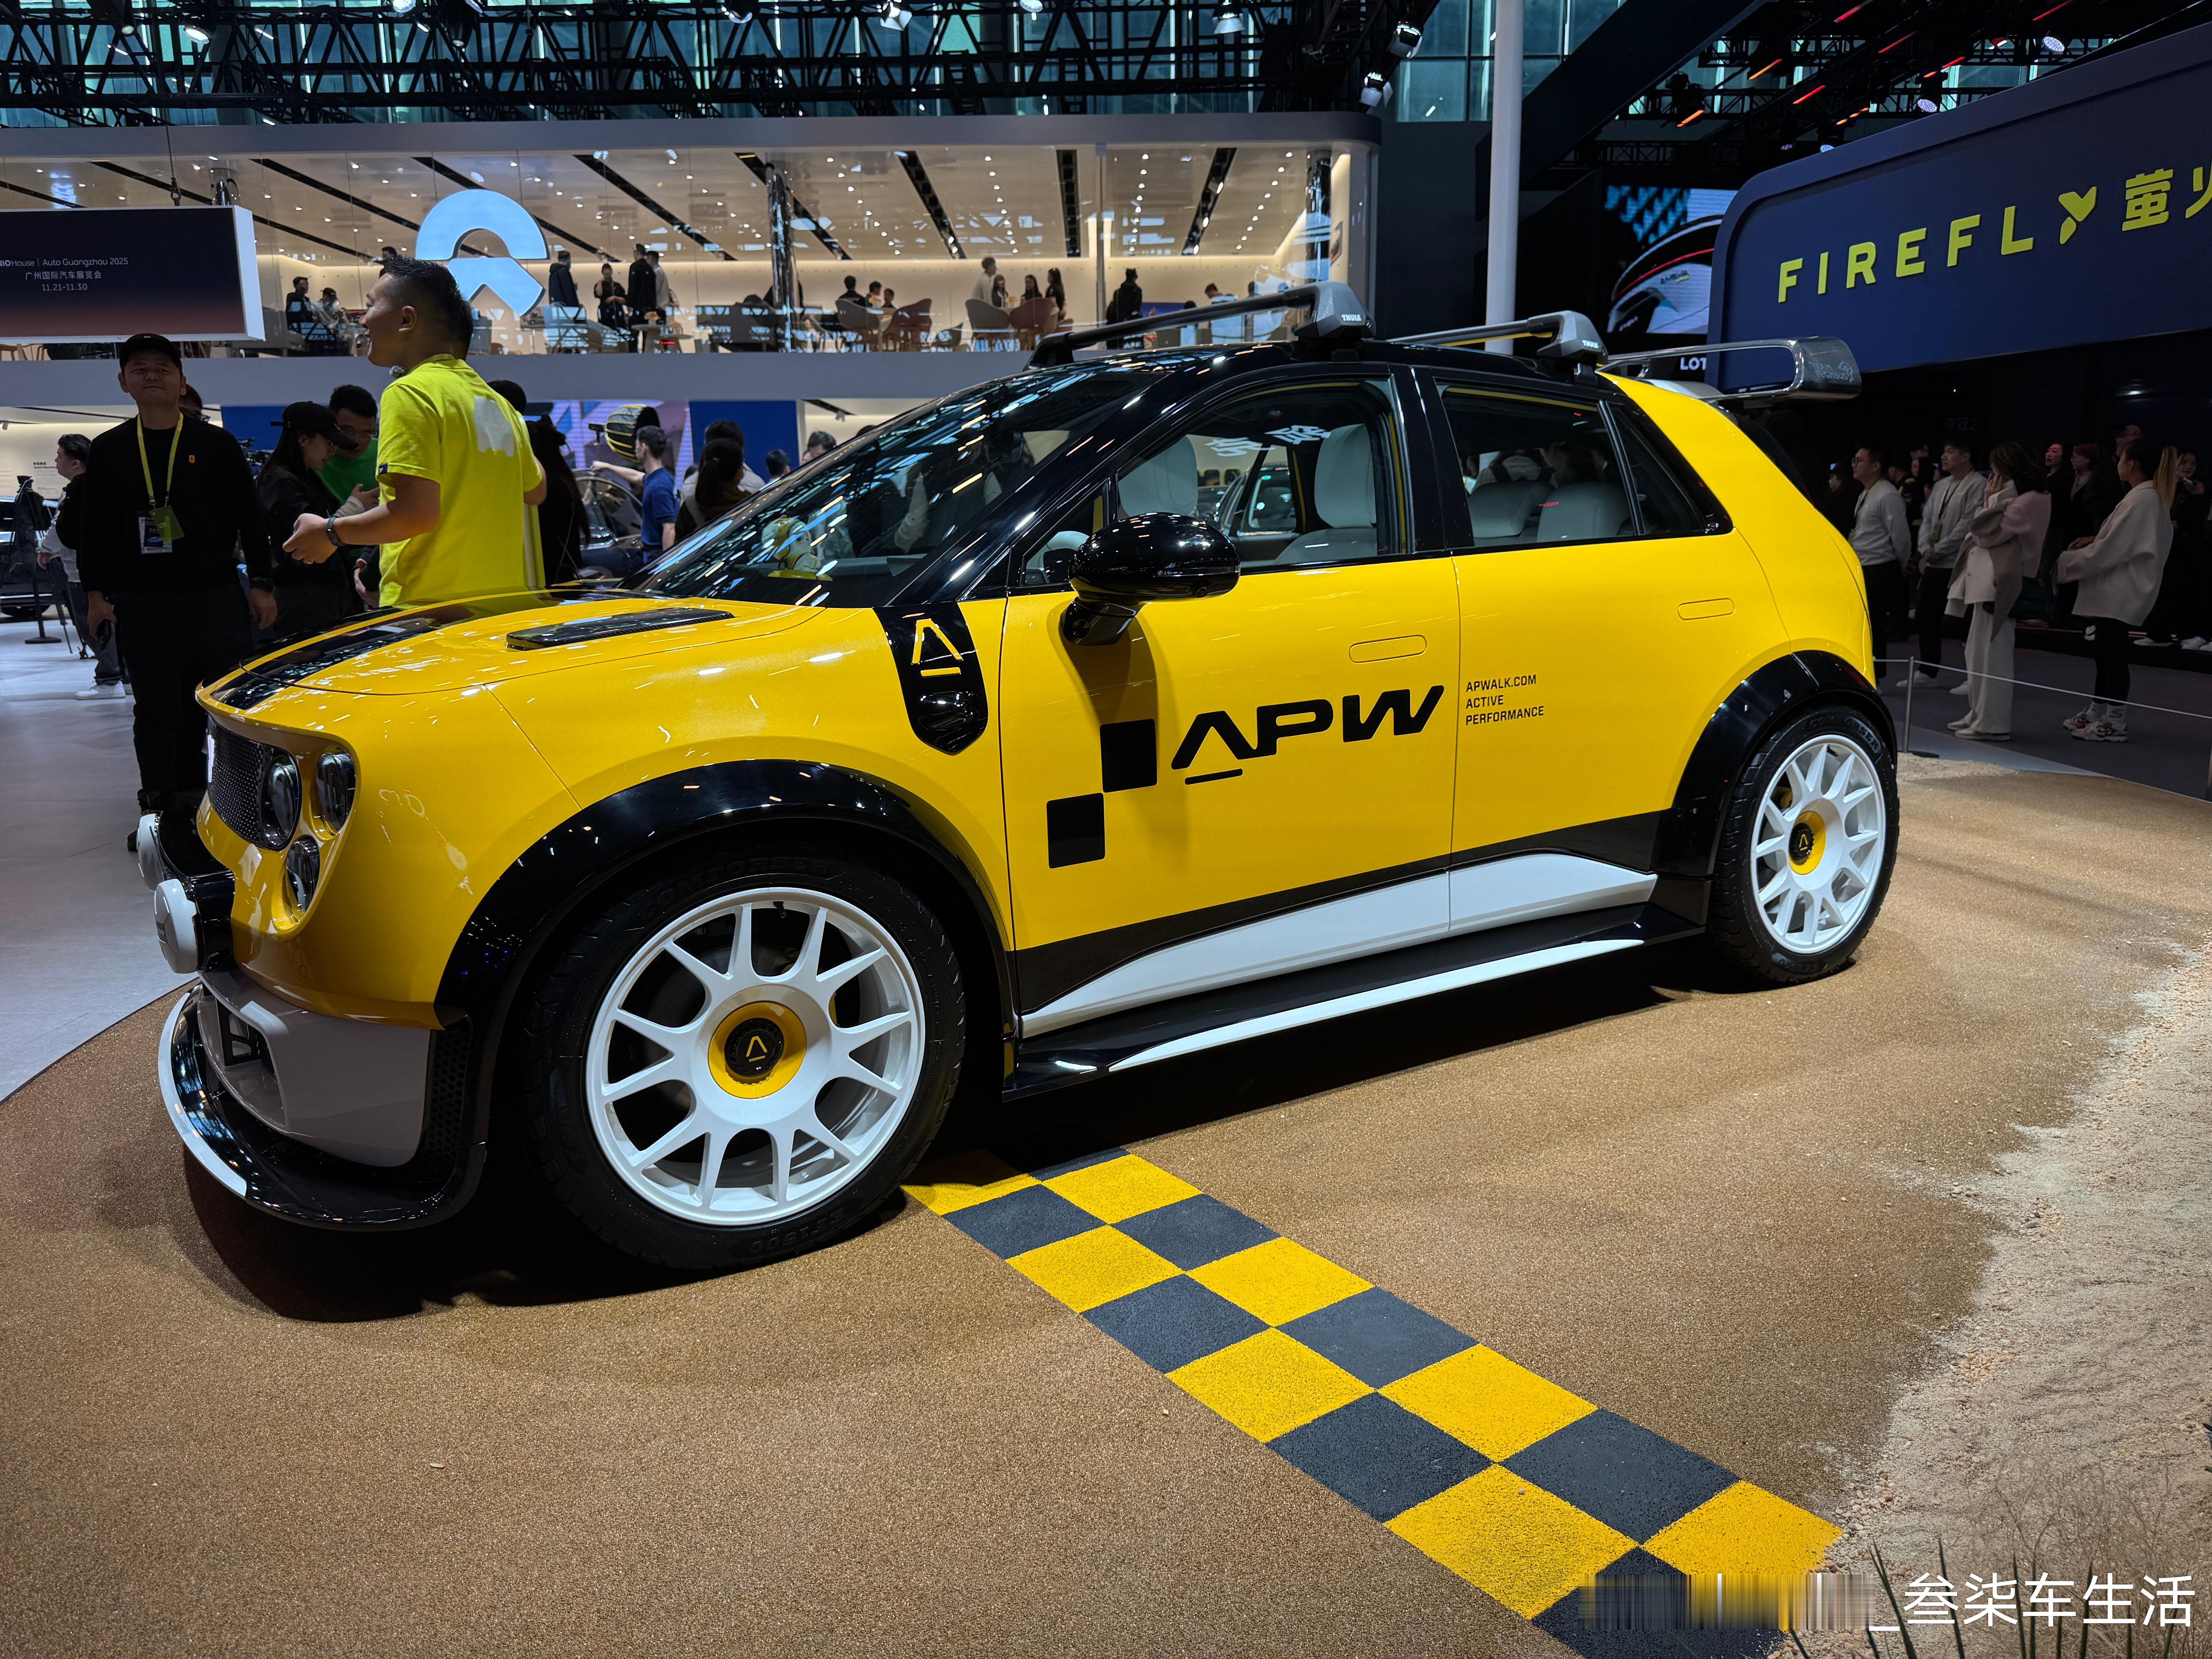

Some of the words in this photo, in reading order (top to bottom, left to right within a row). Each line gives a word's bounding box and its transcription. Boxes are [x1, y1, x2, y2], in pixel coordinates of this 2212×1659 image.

[1778, 187, 2097, 303] FIREFLY
[62, 258, 108, 267] Guangzhou
[26, 270, 102, 280] 广州国际汽车展览会
[1466, 674, 1537, 692] APWALK.COM
[1466, 695, 1504, 709] ACTIVE
[1466, 706, 1544, 726] PERFORMANCE
[1171, 685, 1444, 785] APW
